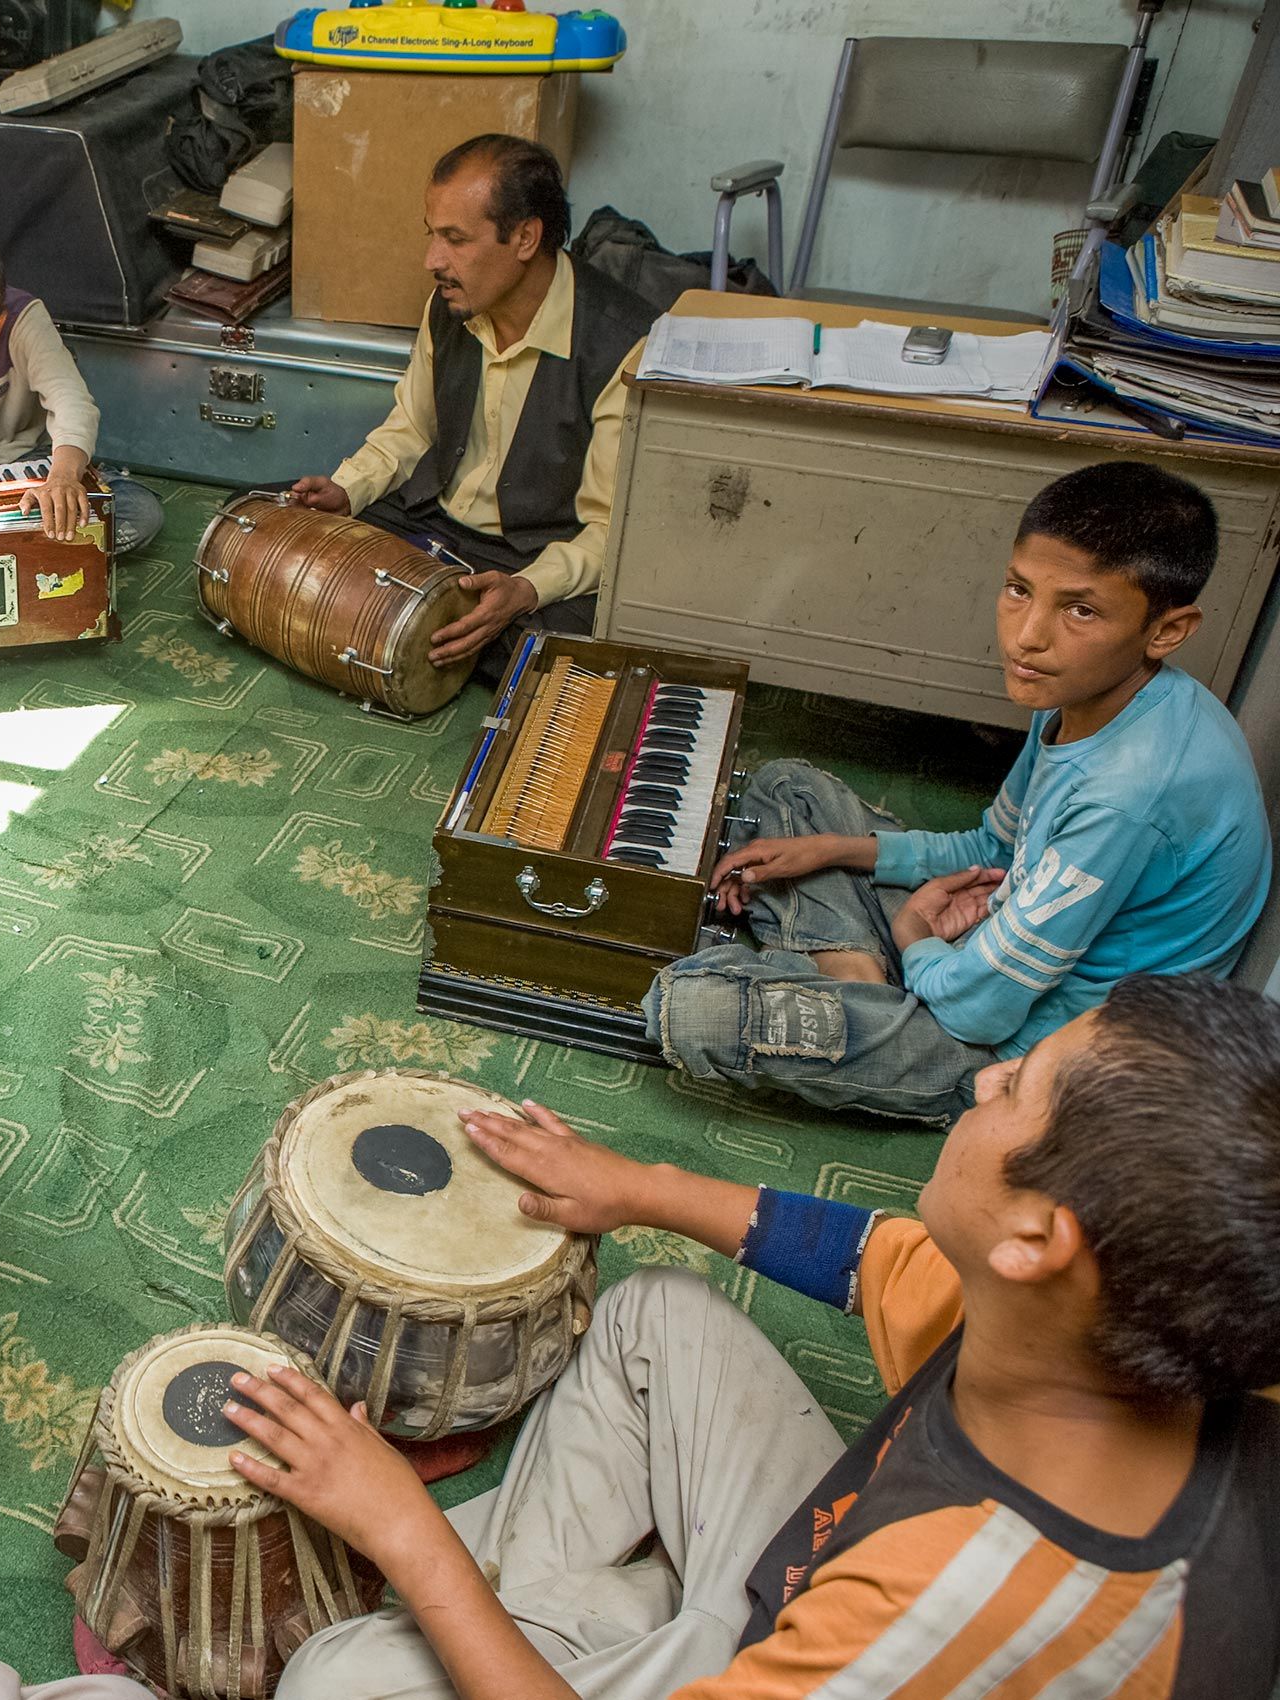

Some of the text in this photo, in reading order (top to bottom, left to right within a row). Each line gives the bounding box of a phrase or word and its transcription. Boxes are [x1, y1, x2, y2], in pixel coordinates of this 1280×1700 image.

[367, 35, 399, 45] Channel
[401, 36, 439, 46] Electronic
[441, 37, 491, 49] Sing-A-Long
[493, 37, 534, 49] Keyboard
